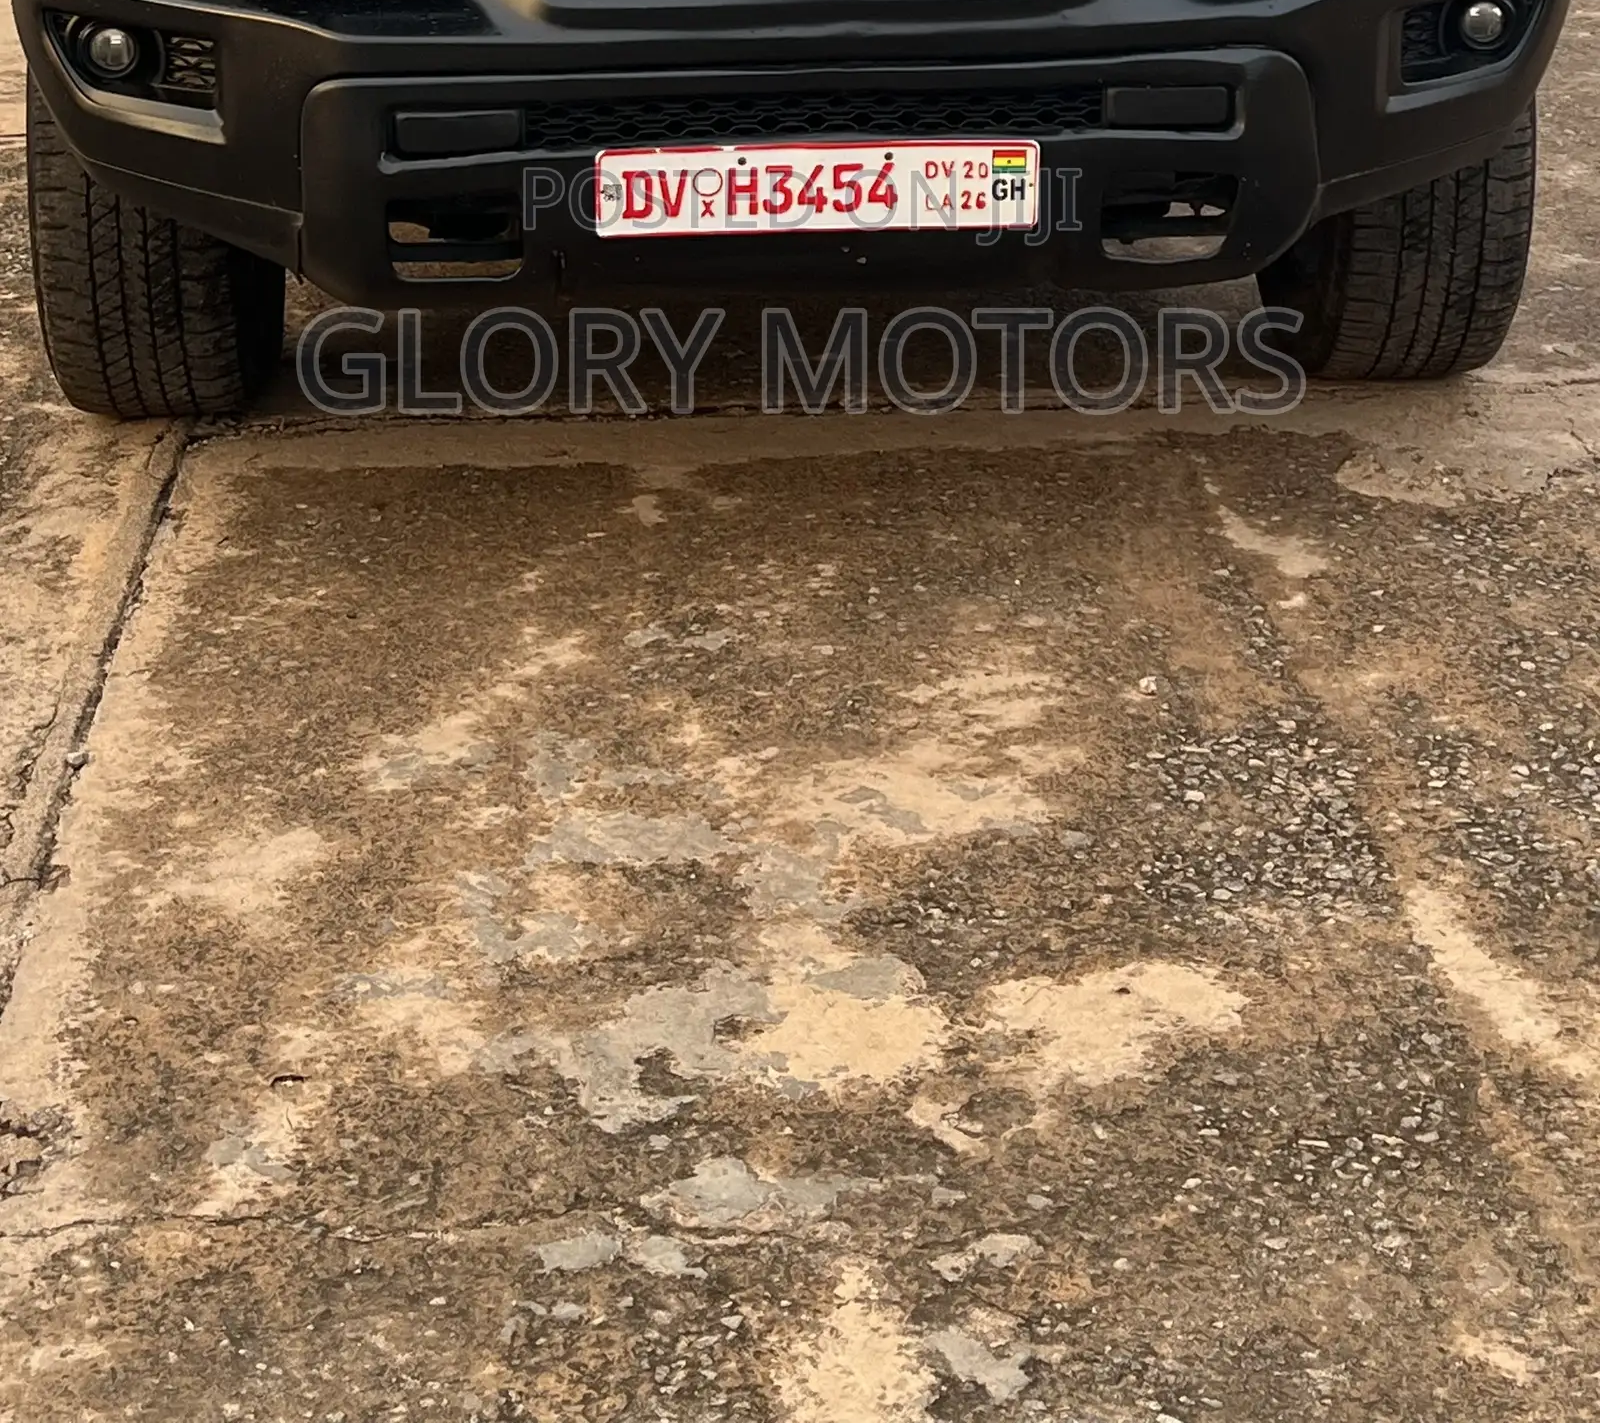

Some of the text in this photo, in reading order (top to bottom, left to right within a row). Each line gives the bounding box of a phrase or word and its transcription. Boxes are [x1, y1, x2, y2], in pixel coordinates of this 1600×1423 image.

[621, 169, 689, 219] DV
[727, 162, 899, 217] H3454
[991, 178, 1026, 202] GH
